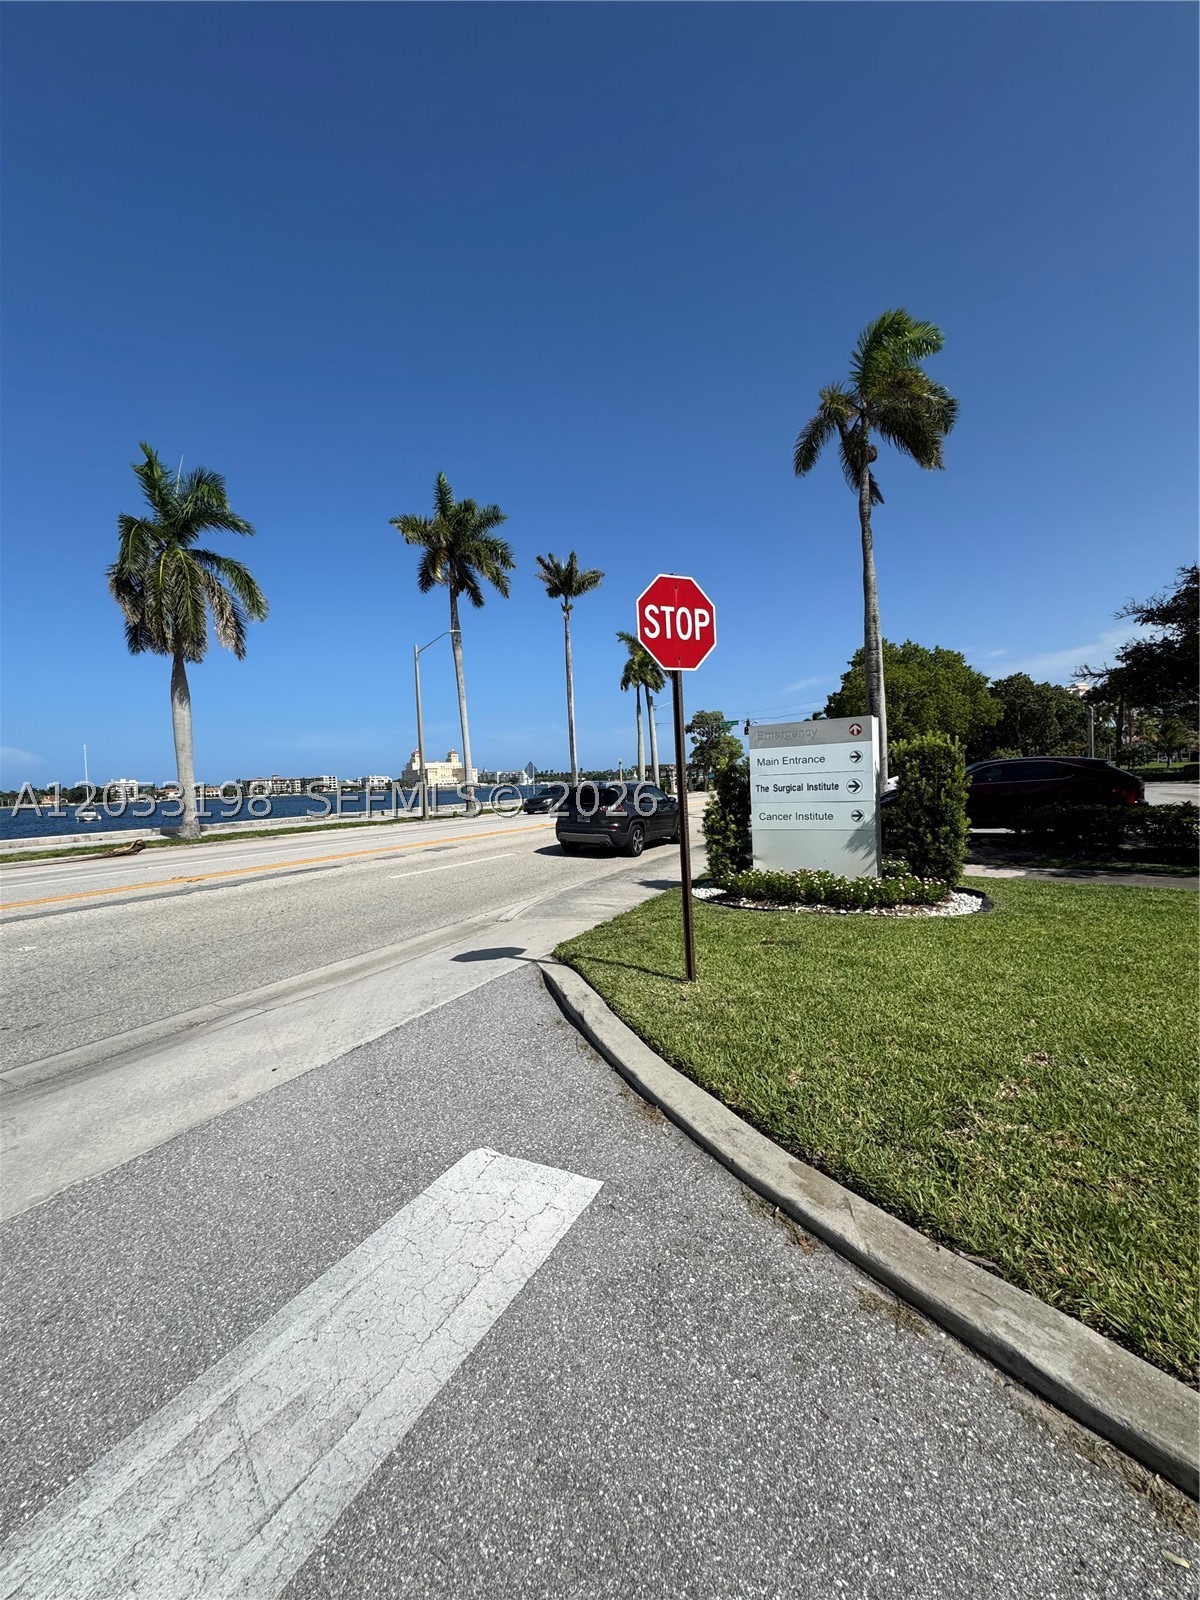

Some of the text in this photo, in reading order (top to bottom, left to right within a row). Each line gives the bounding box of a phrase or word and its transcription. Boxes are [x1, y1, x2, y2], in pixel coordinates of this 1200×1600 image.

[644, 604, 710, 641] STOP
[756, 728, 818, 741] Emergency
[757, 755, 826, 767] Main Entrance
[756, 782, 840, 794] The Surgical Institute
[759, 811, 834, 821] Cancer Institute
